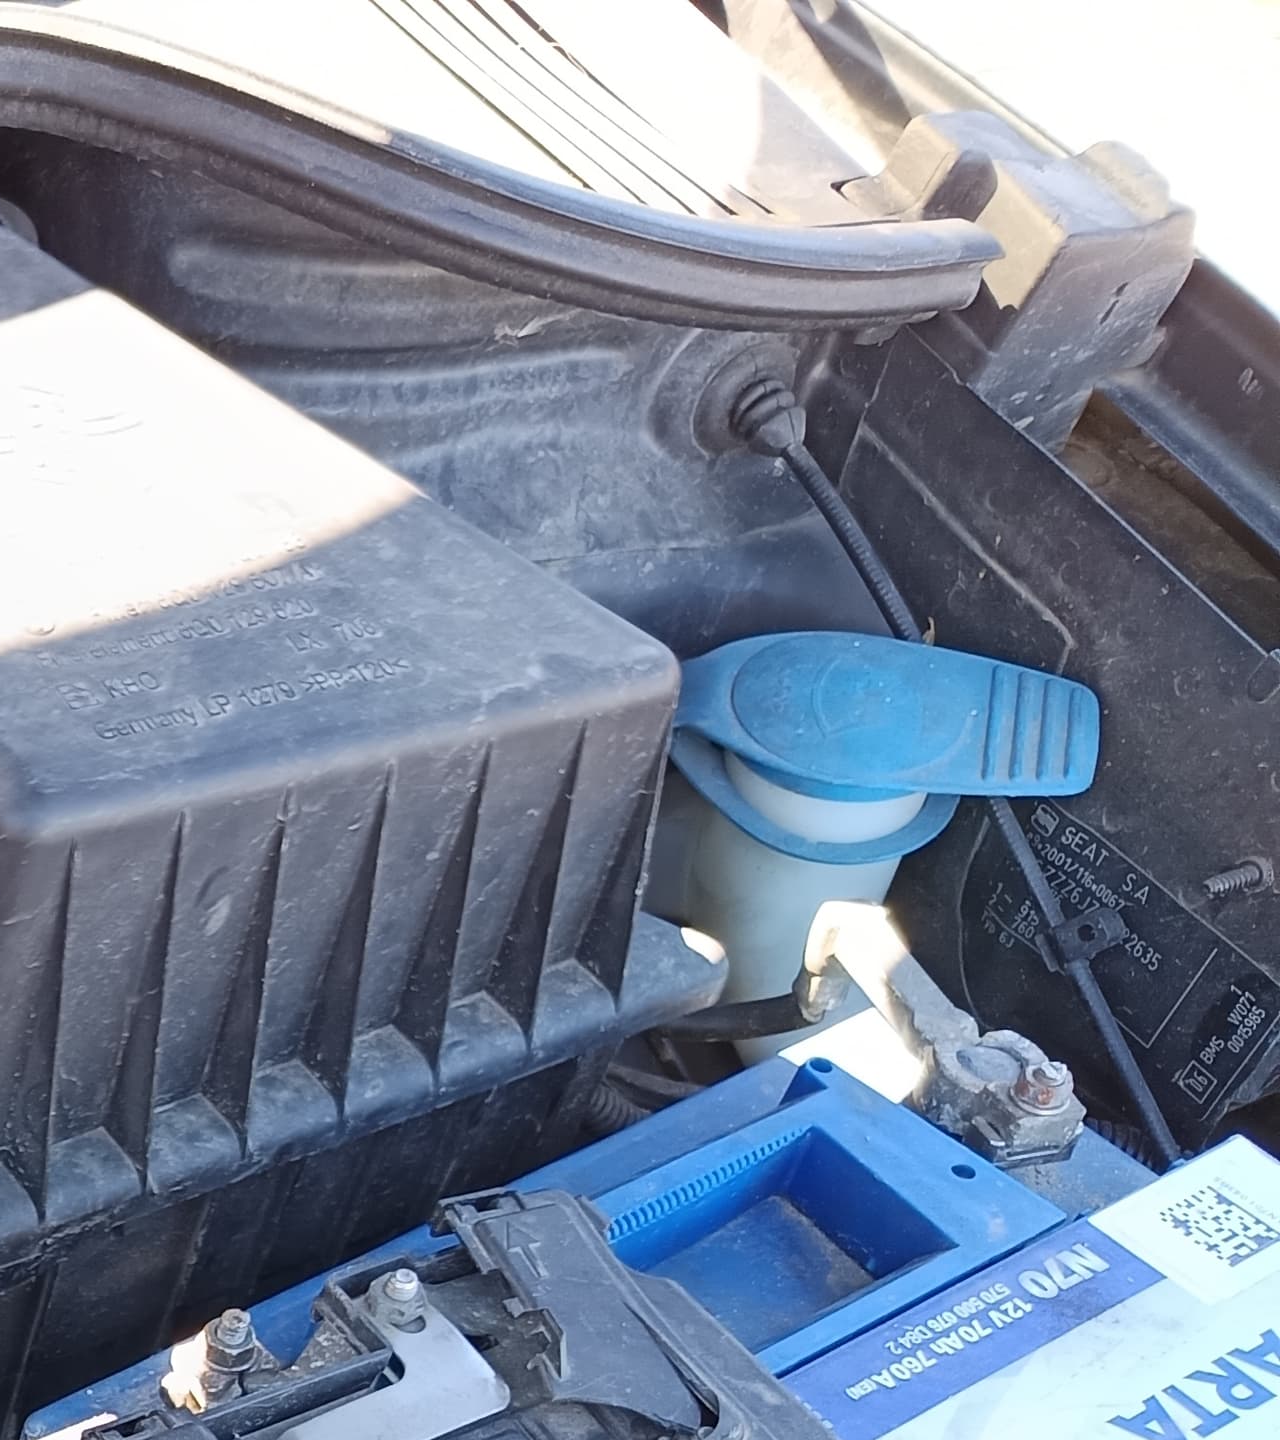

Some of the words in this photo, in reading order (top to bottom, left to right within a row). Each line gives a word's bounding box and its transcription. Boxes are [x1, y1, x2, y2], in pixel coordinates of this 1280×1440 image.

[286, 631, 324, 654] LX
[93, 705, 201, 741] Germany
[204, 693, 234, 718] LP
[1060, 827, 1110, 867] SEAT
[1199, 1035, 1225, 1065] BMS
[1017, 1242, 1112, 1300] N70
[987, 1297, 1034, 1329] 12V
[929, 1318, 993, 1356] 70Ah
